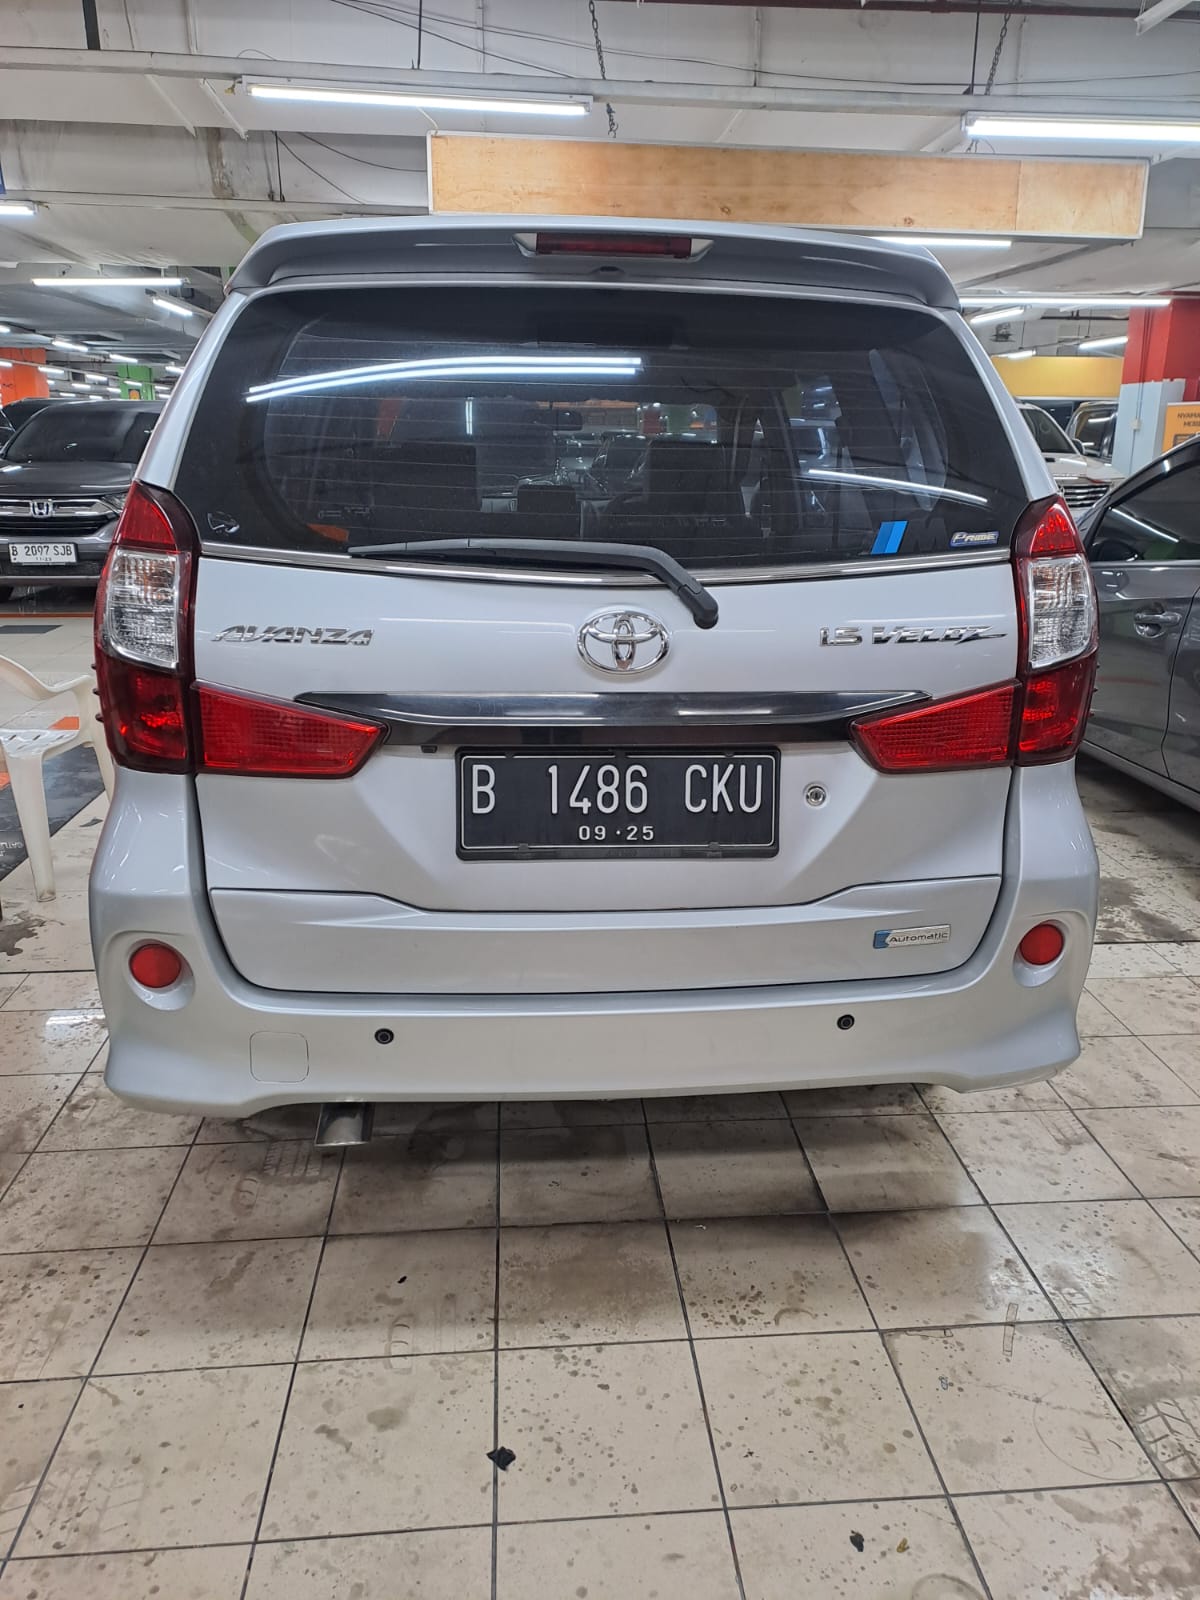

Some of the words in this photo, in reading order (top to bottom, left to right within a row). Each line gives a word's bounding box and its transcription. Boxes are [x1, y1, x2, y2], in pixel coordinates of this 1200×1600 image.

[11, 545, 18, 556] B
[24, 545, 50, 556] 2097
[53, 545, 72, 556] SJB
[211, 625, 374, 646] AVANZA
[872, 625, 1008, 646] VELOZ
[471, 763, 496, 815] B
[548, 763, 648, 815] 1486
[684, 763, 763, 814] CKU
[889, 932, 949, 943] Automatic
